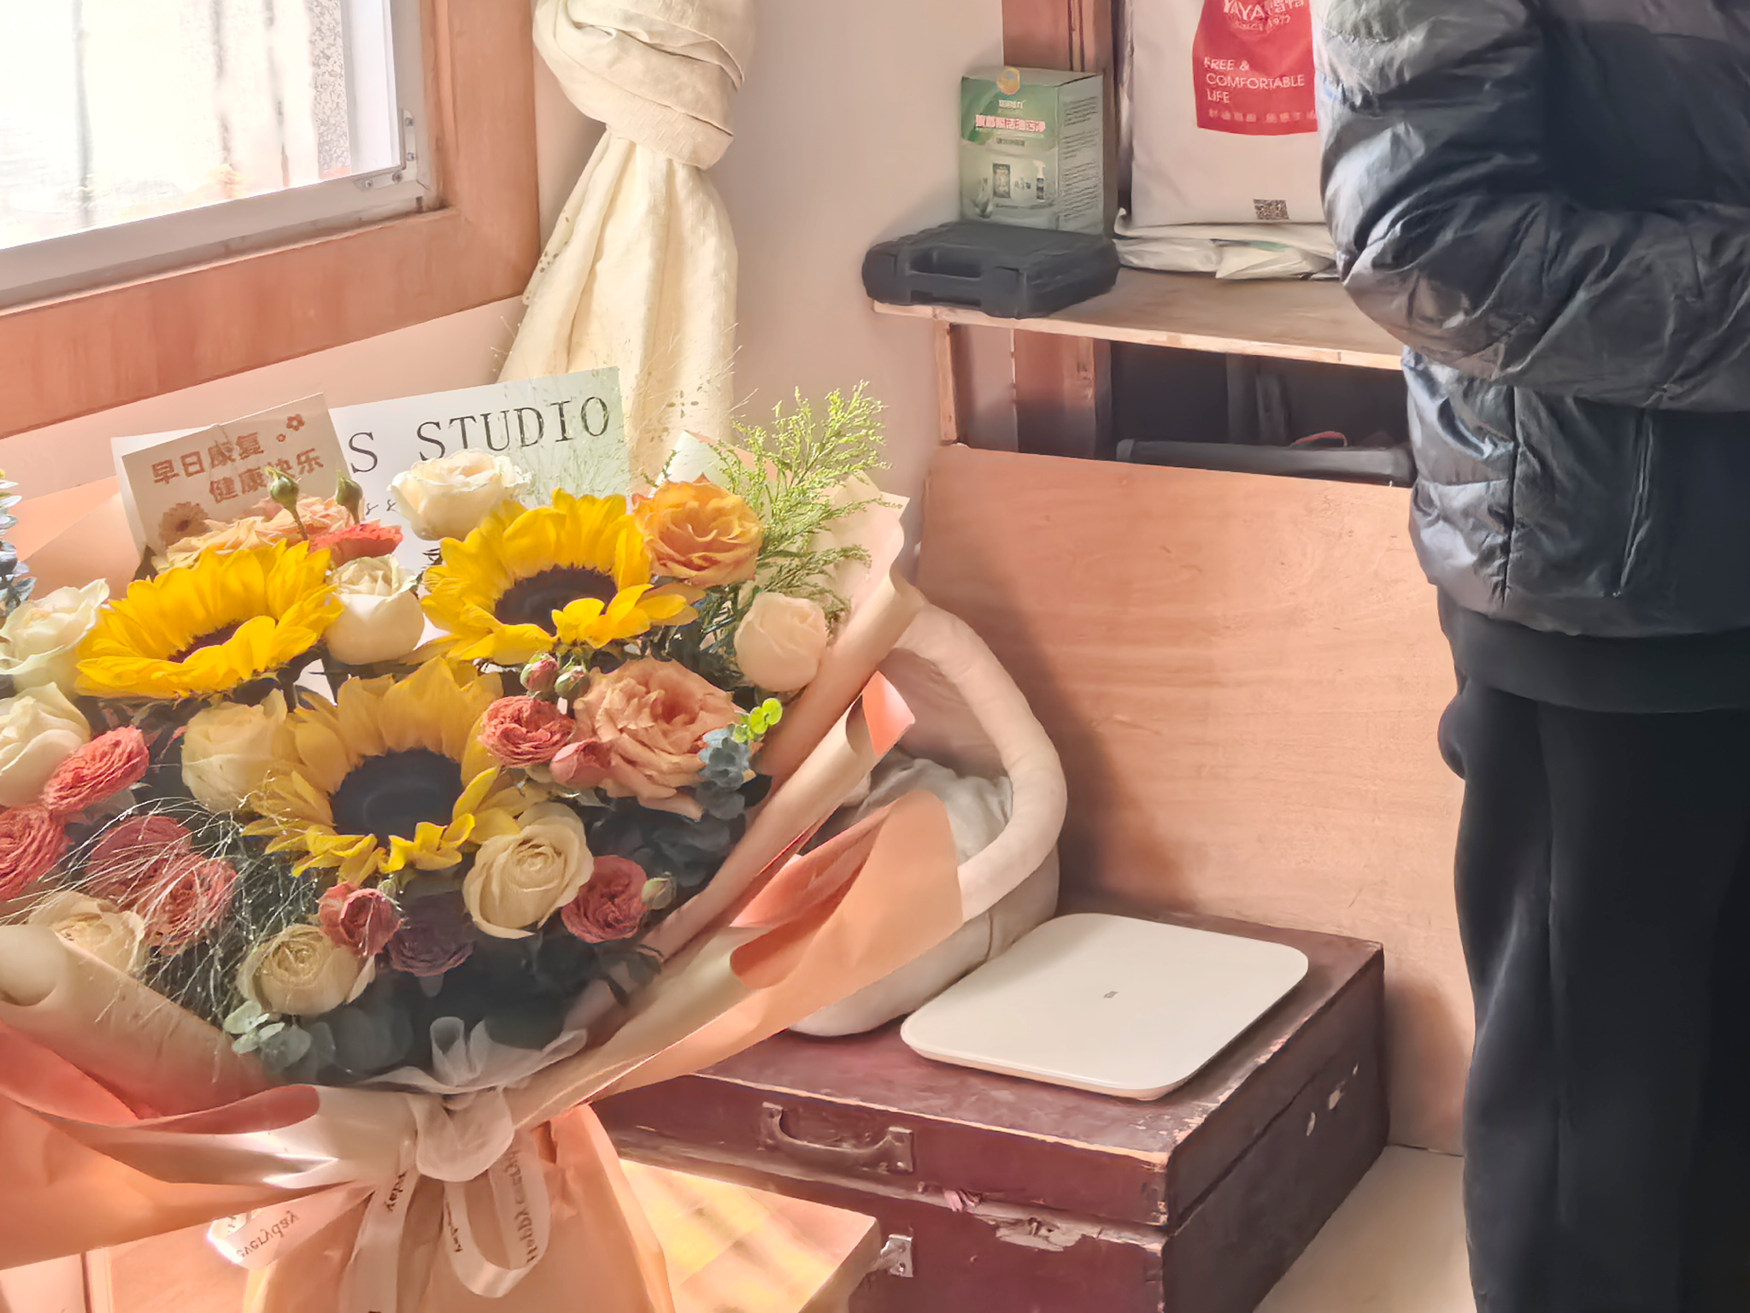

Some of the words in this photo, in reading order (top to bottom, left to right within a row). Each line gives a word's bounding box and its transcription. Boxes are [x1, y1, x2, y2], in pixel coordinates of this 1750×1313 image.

[1204, 57, 1235, 71] FREE
[1206, 73, 1305, 90] COMFORTABLE
[1207, 89, 1231, 104] LIFE
[417, 395, 611, 461] STUDIO
[151, 432, 265, 485] 早日康复
